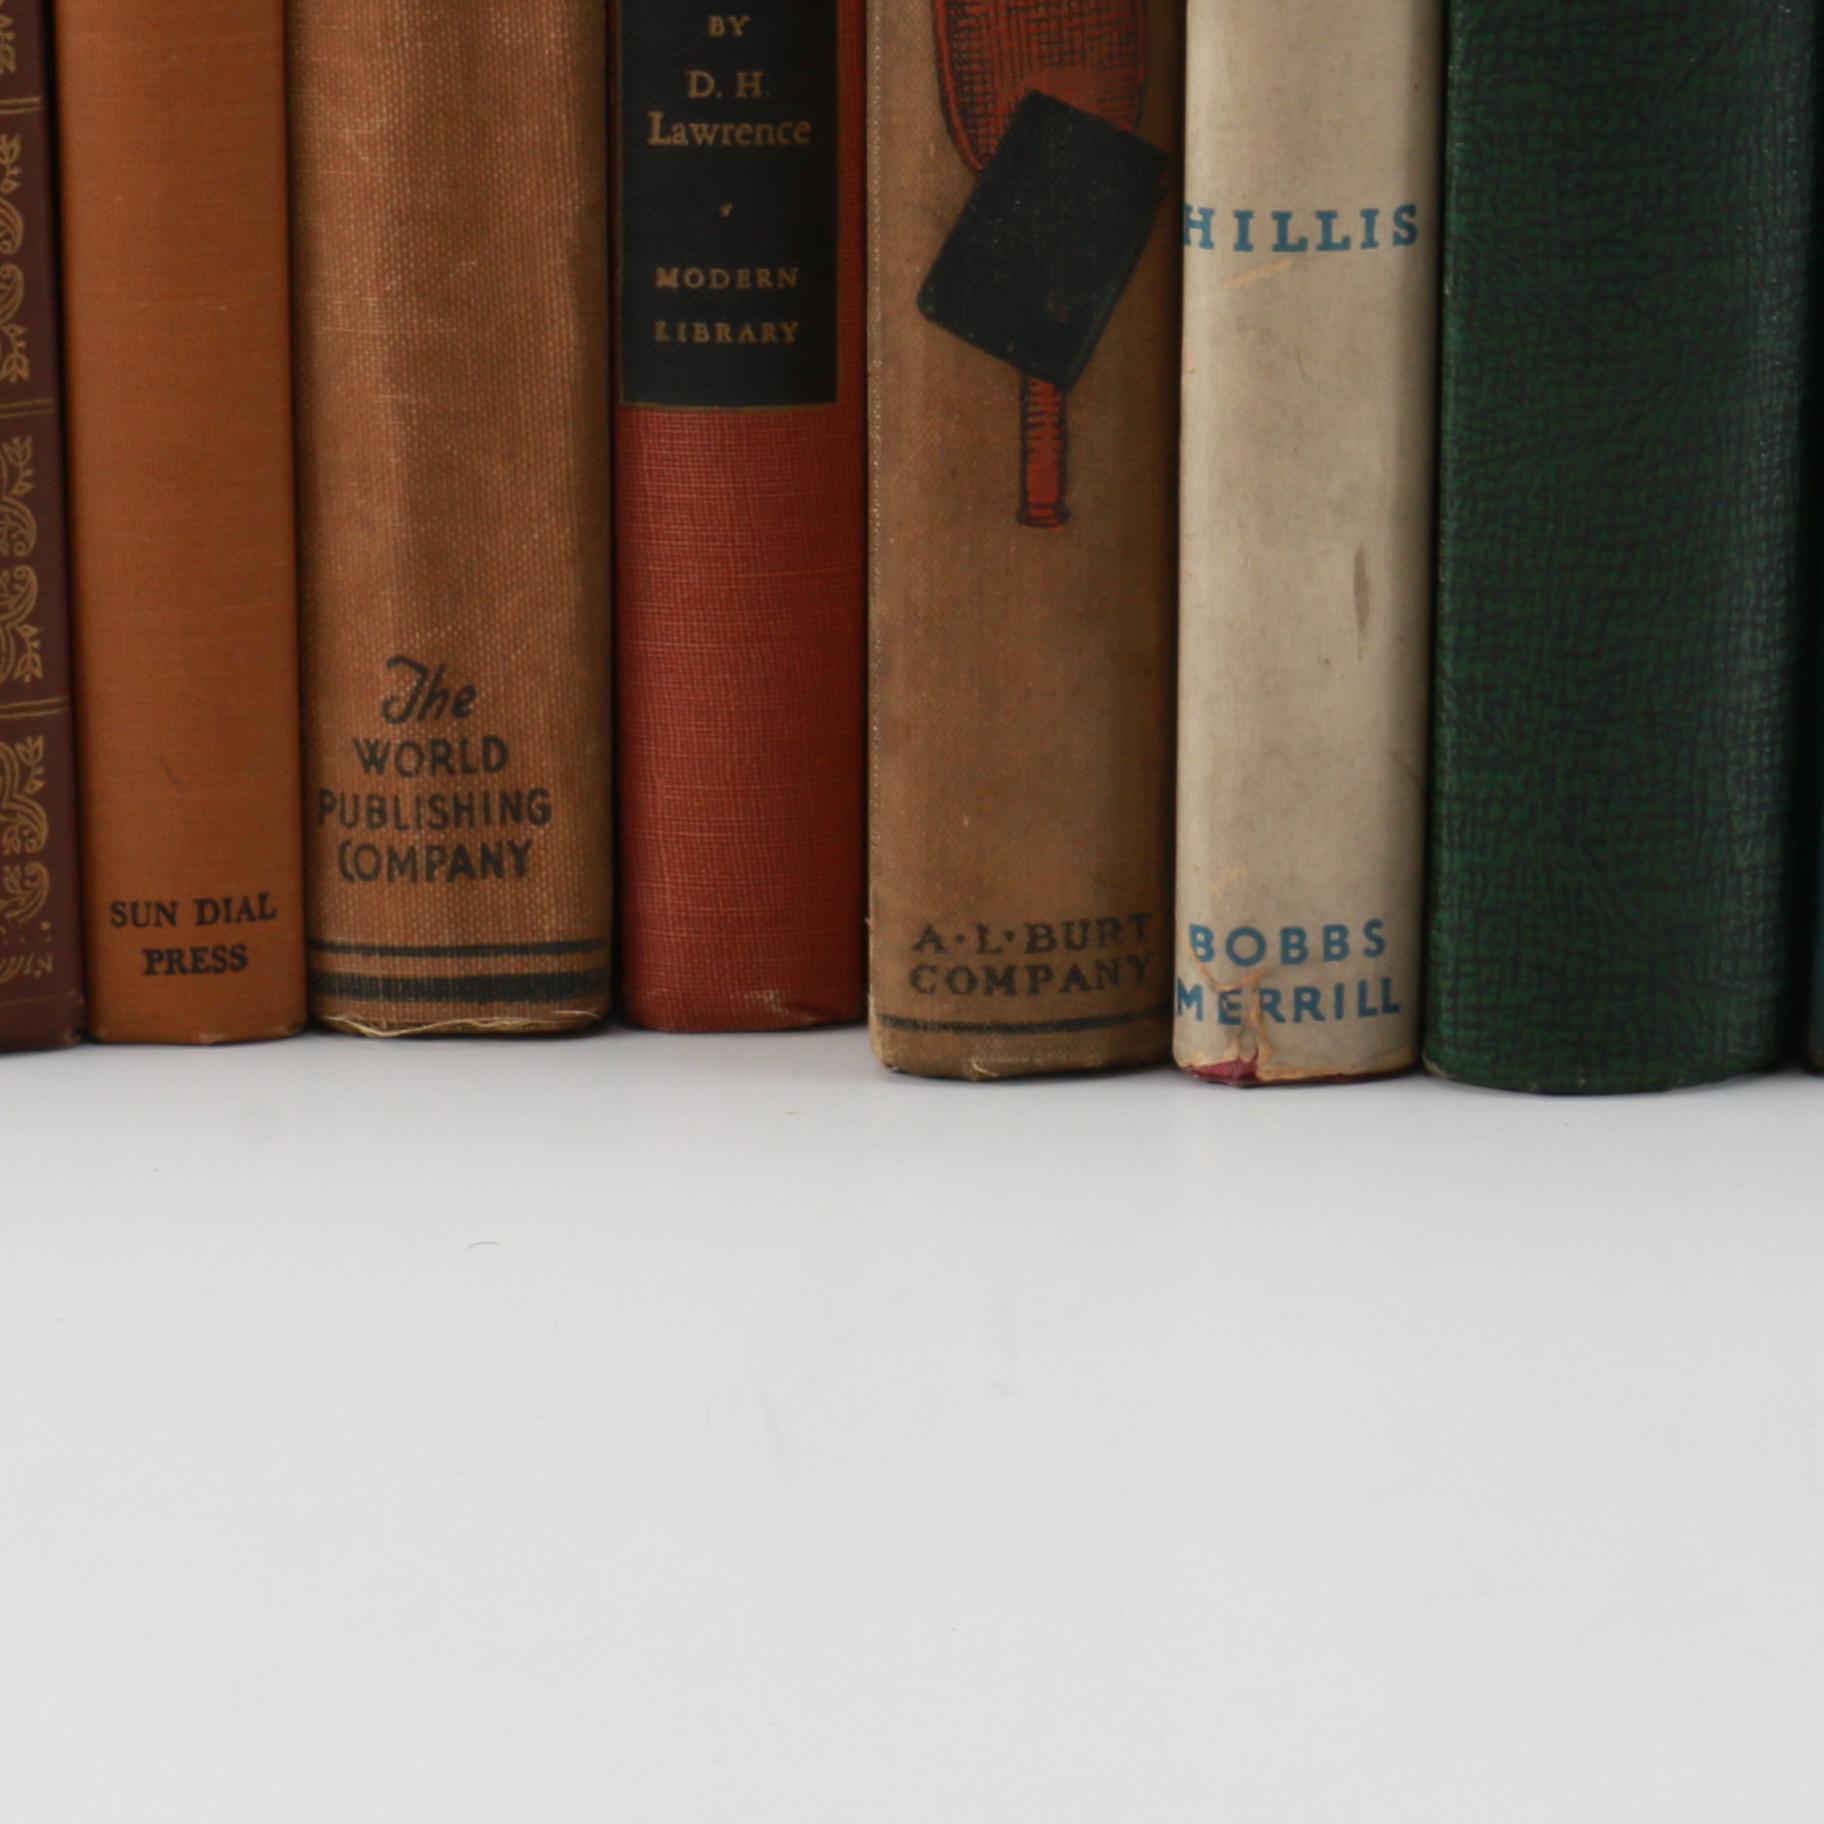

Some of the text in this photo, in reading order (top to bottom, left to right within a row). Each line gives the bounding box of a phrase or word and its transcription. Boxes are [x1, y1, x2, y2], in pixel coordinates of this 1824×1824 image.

[707, 15, 749, 37] BY
[687, 71, 722, 98] D.
[647, 112, 811, 147] Lawrence
[1183, 203, 1418, 252] HILLIS
[655, 267, 799, 289] MODERN
[654, 321, 798, 344] LIBRARY
[381, 655, 477, 725] The
[354, 735, 509, 778] WORLD
[319, 788, 553, 831] PUBLISHING
[337, 839, 533, 884] COMPANY
[109, 893, 277, 928] SUN DIAL
[142, 943, 248, 976] PRESS
[1189, 919, 1386, 967] BOBBS
[910, 952, 1154, 996] COMPANY
[1176, 979, 1400, 1026] MERRILL
